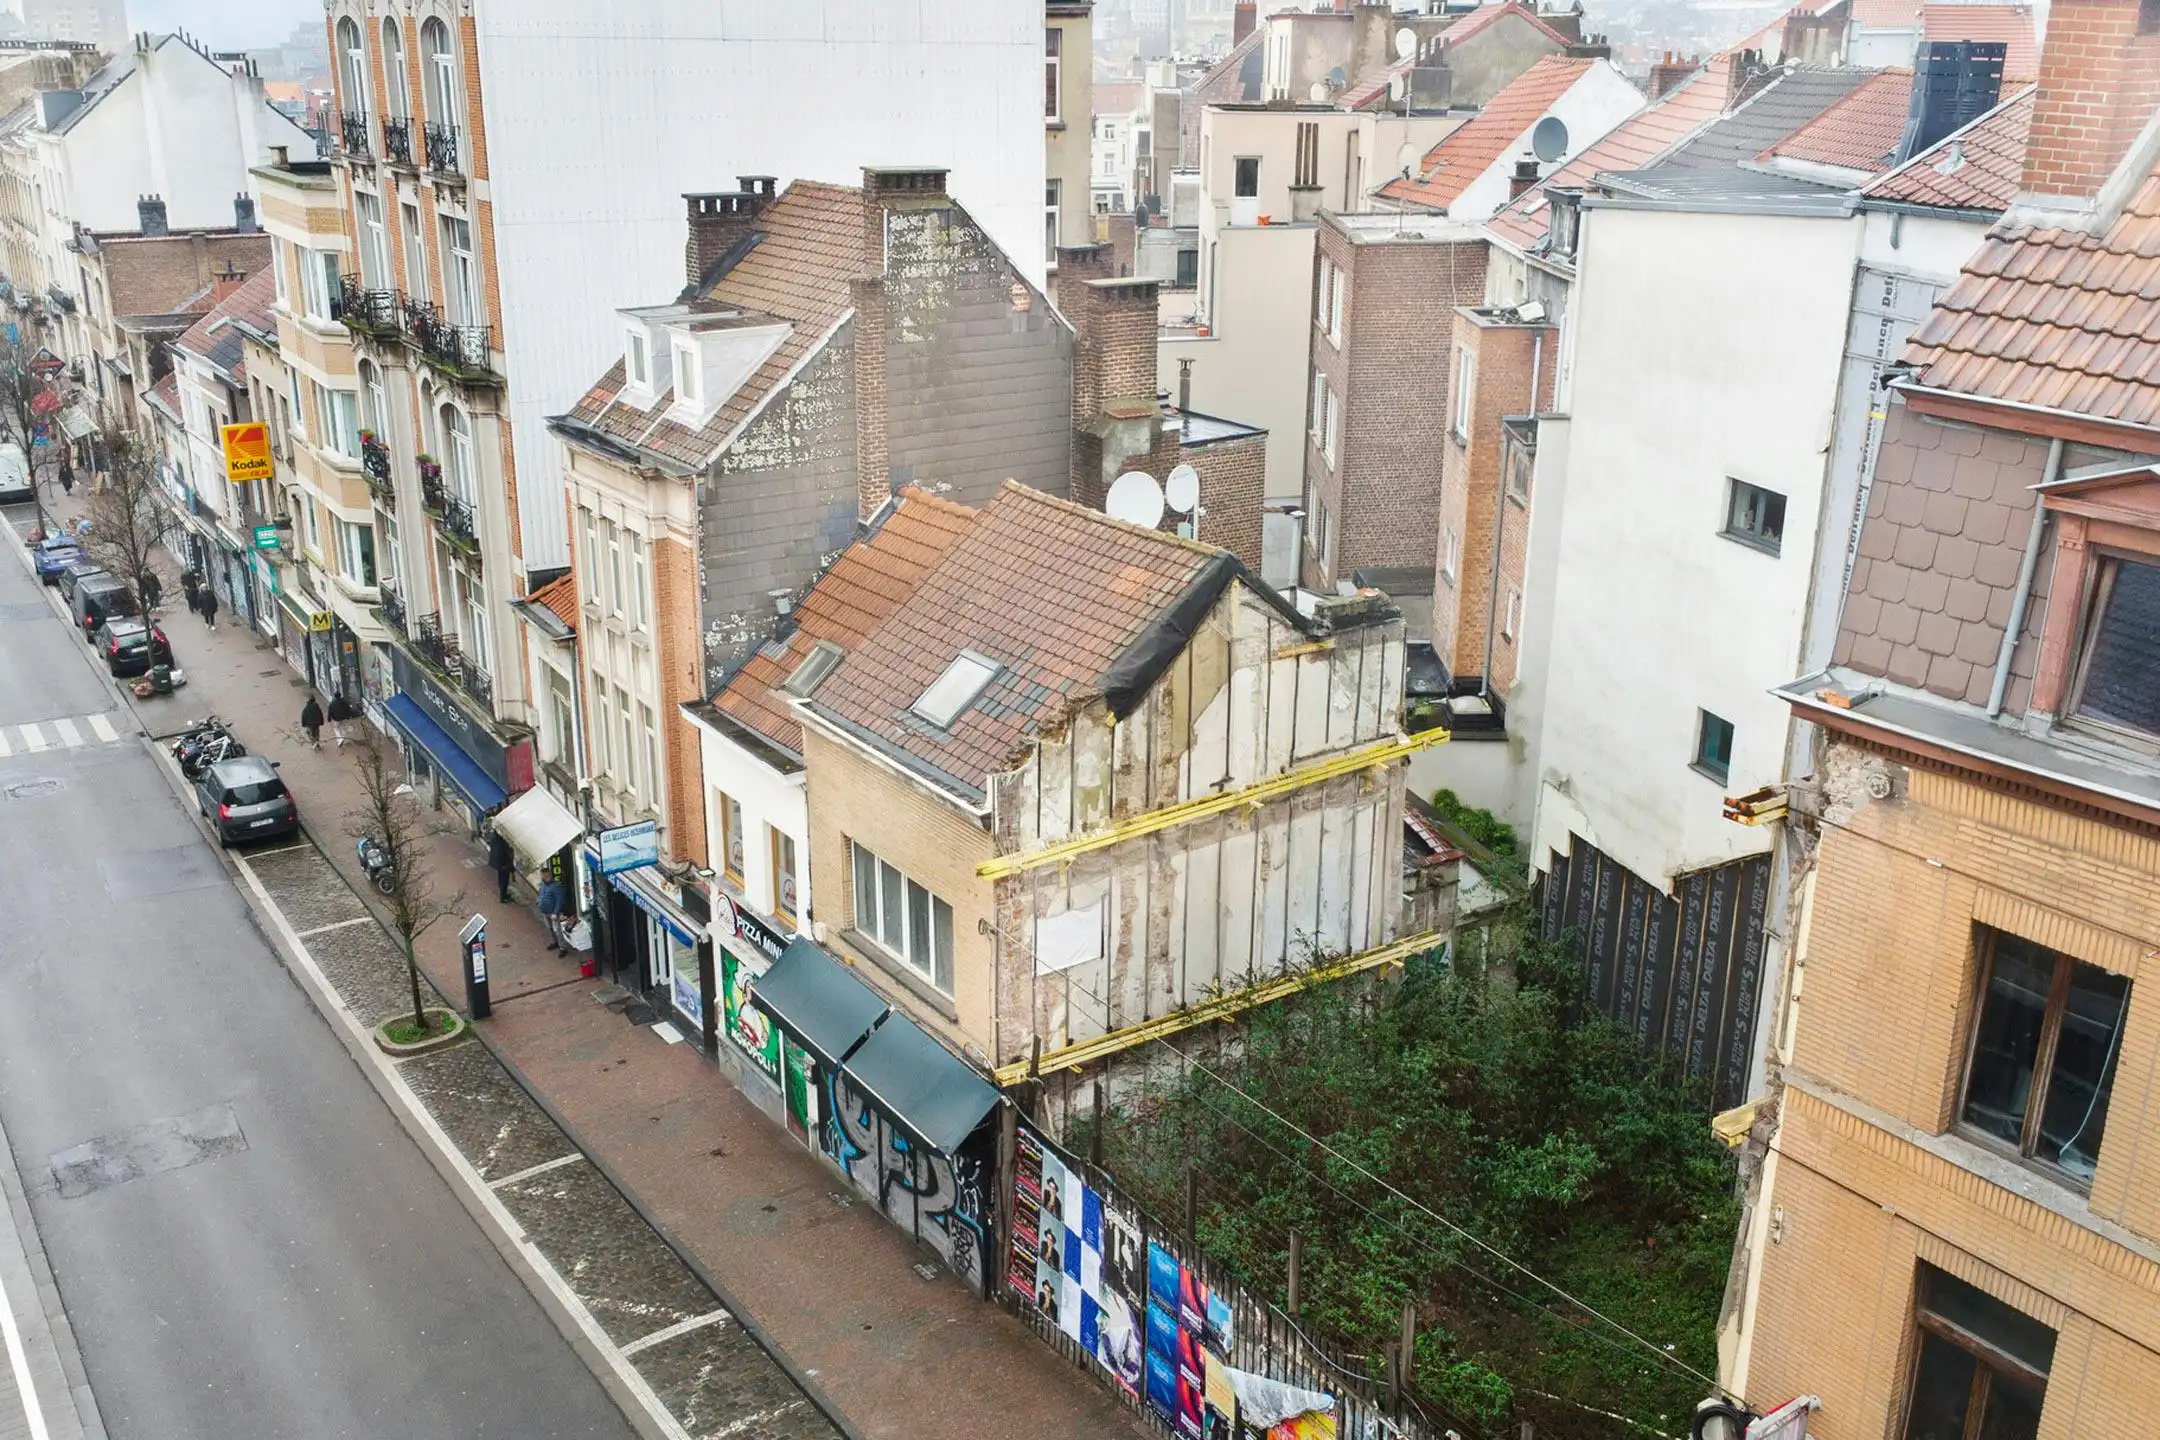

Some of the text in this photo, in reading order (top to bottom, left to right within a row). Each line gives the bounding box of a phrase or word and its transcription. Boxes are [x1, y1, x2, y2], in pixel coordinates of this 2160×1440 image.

[231, 458, 267, 471] Kodak
[313, 614, 328, 625] M
[1551, 864, 1564, 902] DELTA
[1756, 861, 1769, 878] S
[736, 916, 762, 946] PIZZA
[1593, 916, 1607, 956] DELTA
[1600, 871, 1613, 911] DELTA
[1709, 890, 1724, 933] DELTA
[1647, 921, 1661, 962] DELTA
[1702, 940, 1718, 983] DELTA
[1642, 969, 1655, 1009] DELTA
[1695, 990, 1711, 1032] DELTA
